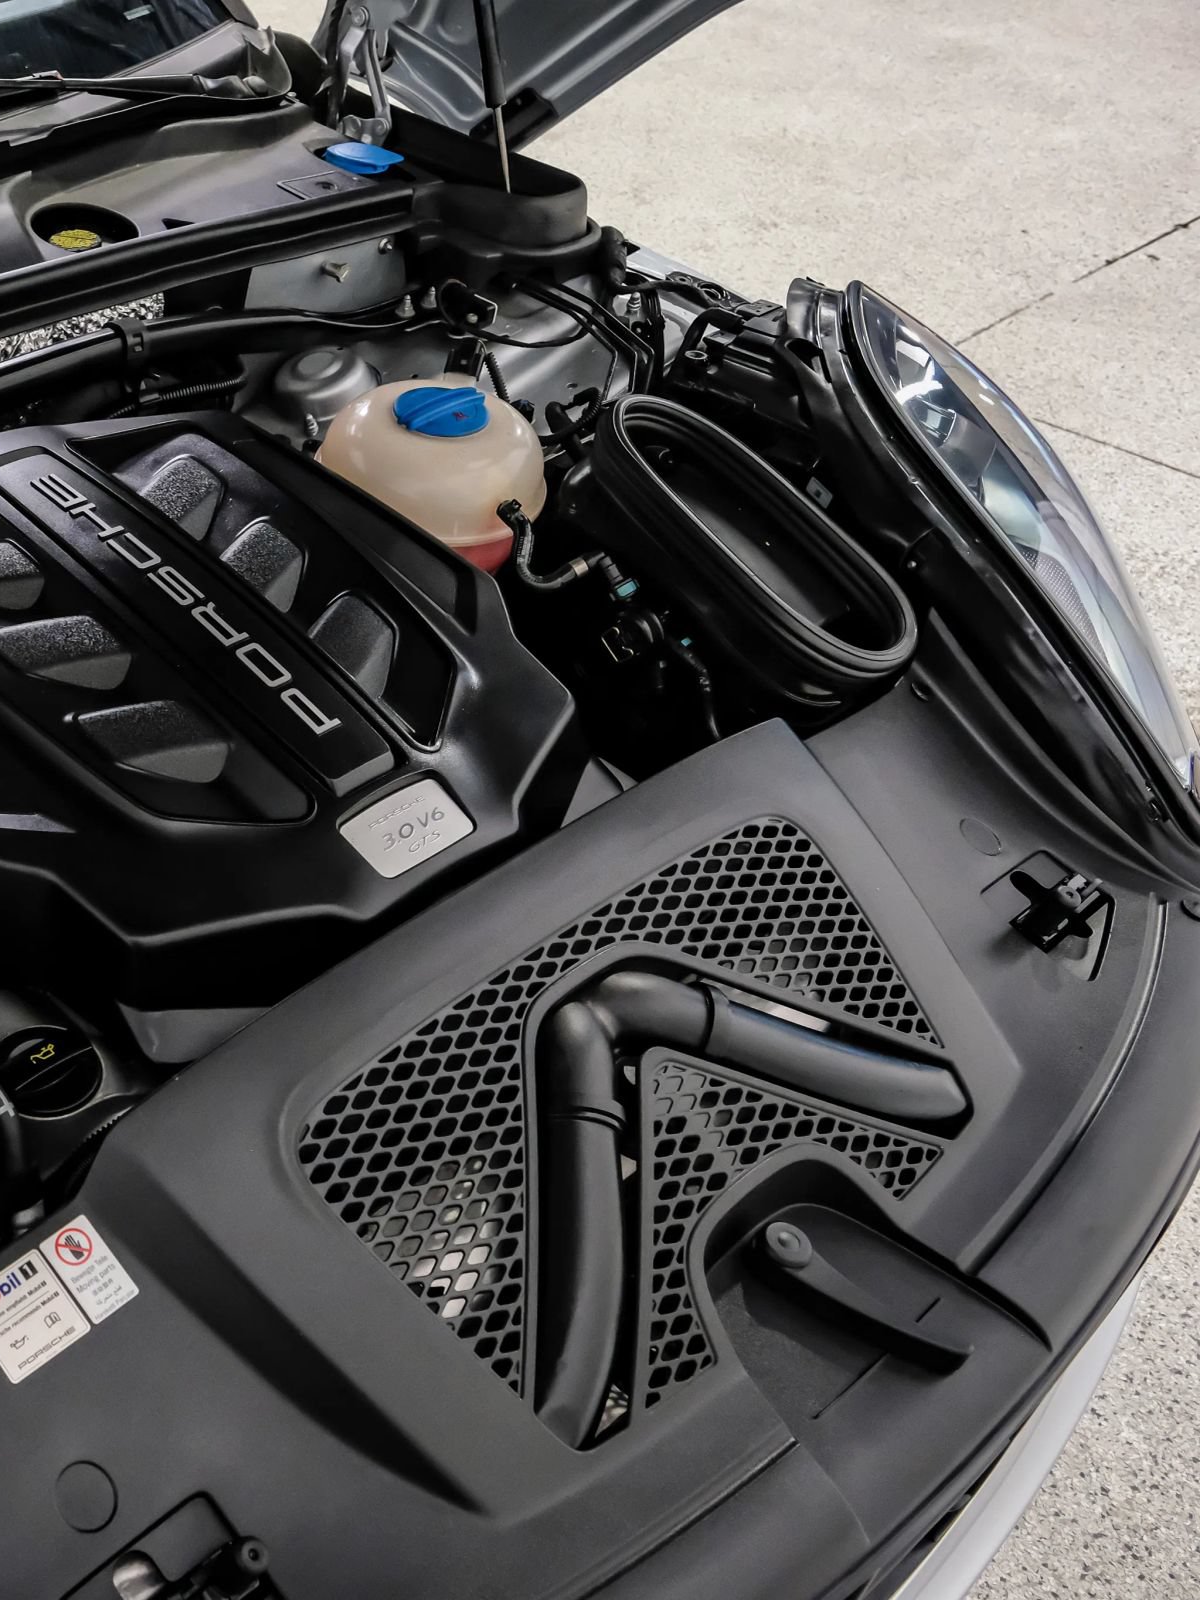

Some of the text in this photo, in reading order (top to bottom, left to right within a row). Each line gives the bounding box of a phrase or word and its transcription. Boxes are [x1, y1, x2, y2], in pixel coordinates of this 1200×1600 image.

[30, 473, 343, 736] PORSCHE
[368, 796, 425, 829] PORSCHE
[382, 807, 445, 852] 3.0 V6
[408, 831, 441, 853] GTS
[21, 1261, 36, 1279] 1
[76, 1275, 99, 1294] Moving
[98, 1263, 116, 1278] parts
[18, 1326, 76, 1370] PORSCHE
